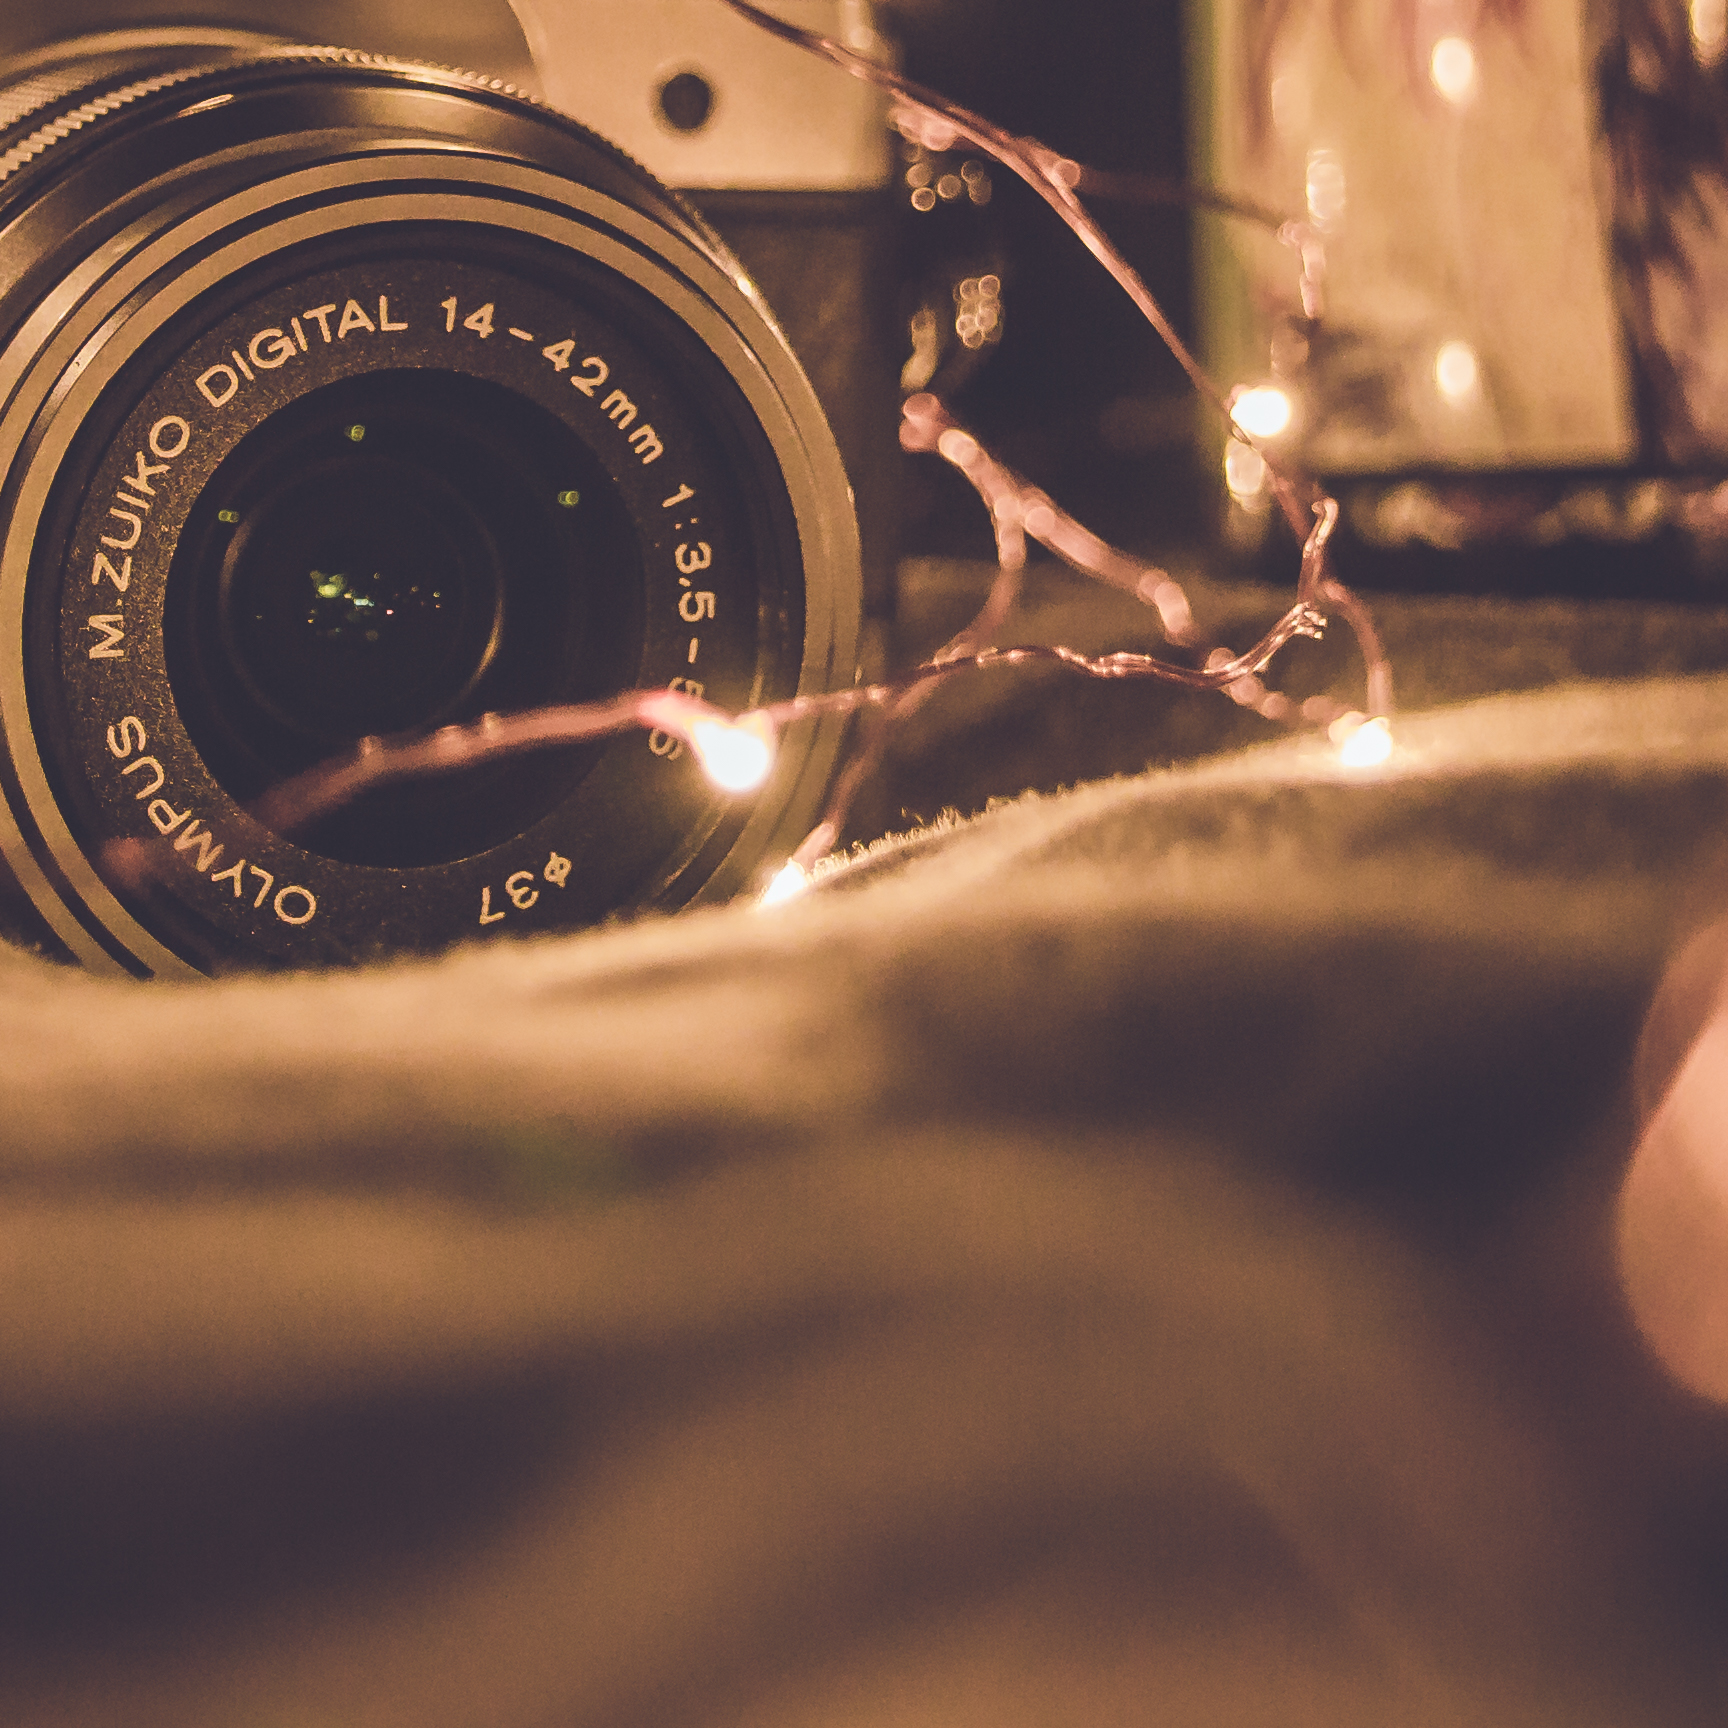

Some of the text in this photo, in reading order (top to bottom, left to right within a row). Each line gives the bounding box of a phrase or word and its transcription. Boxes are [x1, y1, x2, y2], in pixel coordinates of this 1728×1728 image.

[196, 294, 409, 409] DIGITAL
[441, 295, 665, 465] 14-42mm
[88, 414, 192, 661] M.ZUIKO
[108, 714, 318, 926] OLYMPUS
